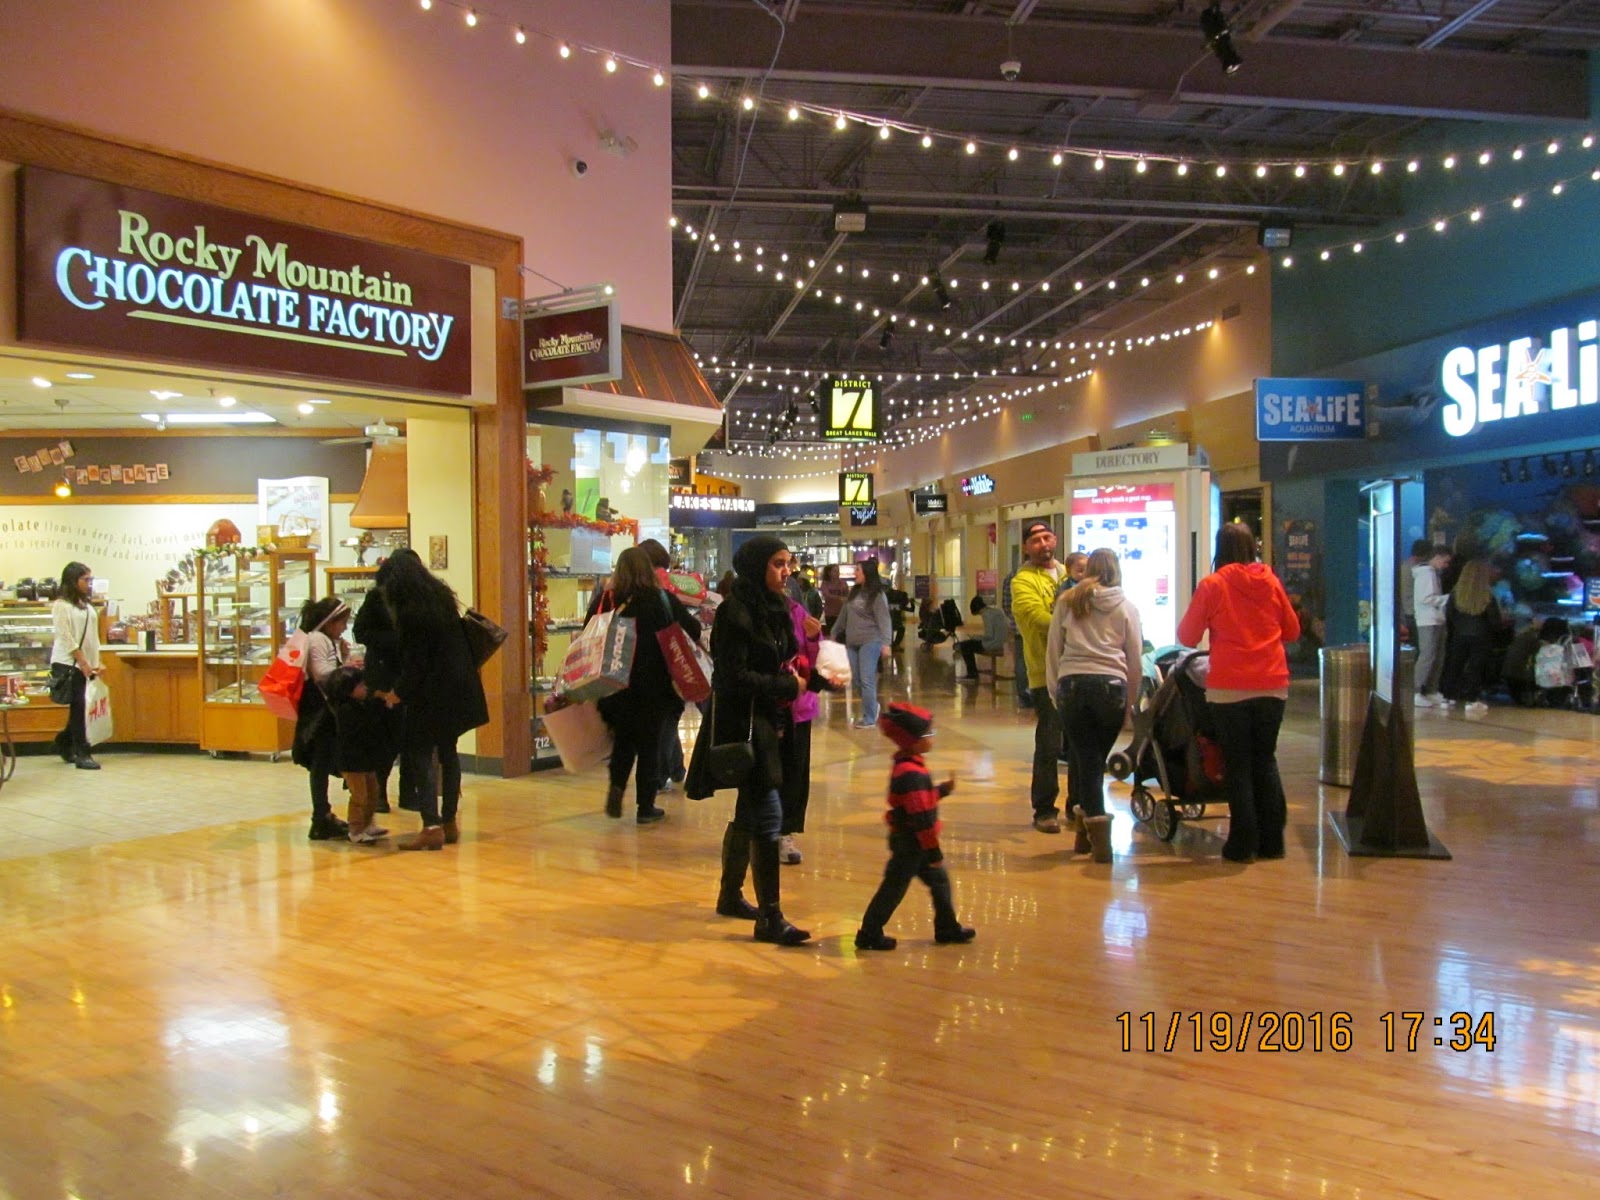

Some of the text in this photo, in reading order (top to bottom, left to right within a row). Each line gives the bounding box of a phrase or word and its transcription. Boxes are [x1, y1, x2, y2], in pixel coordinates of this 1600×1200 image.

[118, 210, 413, 306] Rocky Mountain
[55, 247, 454, 361] CHOCOLATE FACTORY
[530, 338, 602, 361] CHOCOLATE FACTORY
[539, 332, 593, 348] Rocky Mountain
[834, 380, 871, 388] DISTRICT
[1443, 337, 1540, 437] SEA
[1263, 393, 1310, 426] SEA
[1290, 425, 1335, 433] AQUARIUM
[1096, 451, 1160, 468] DIRECTORY
